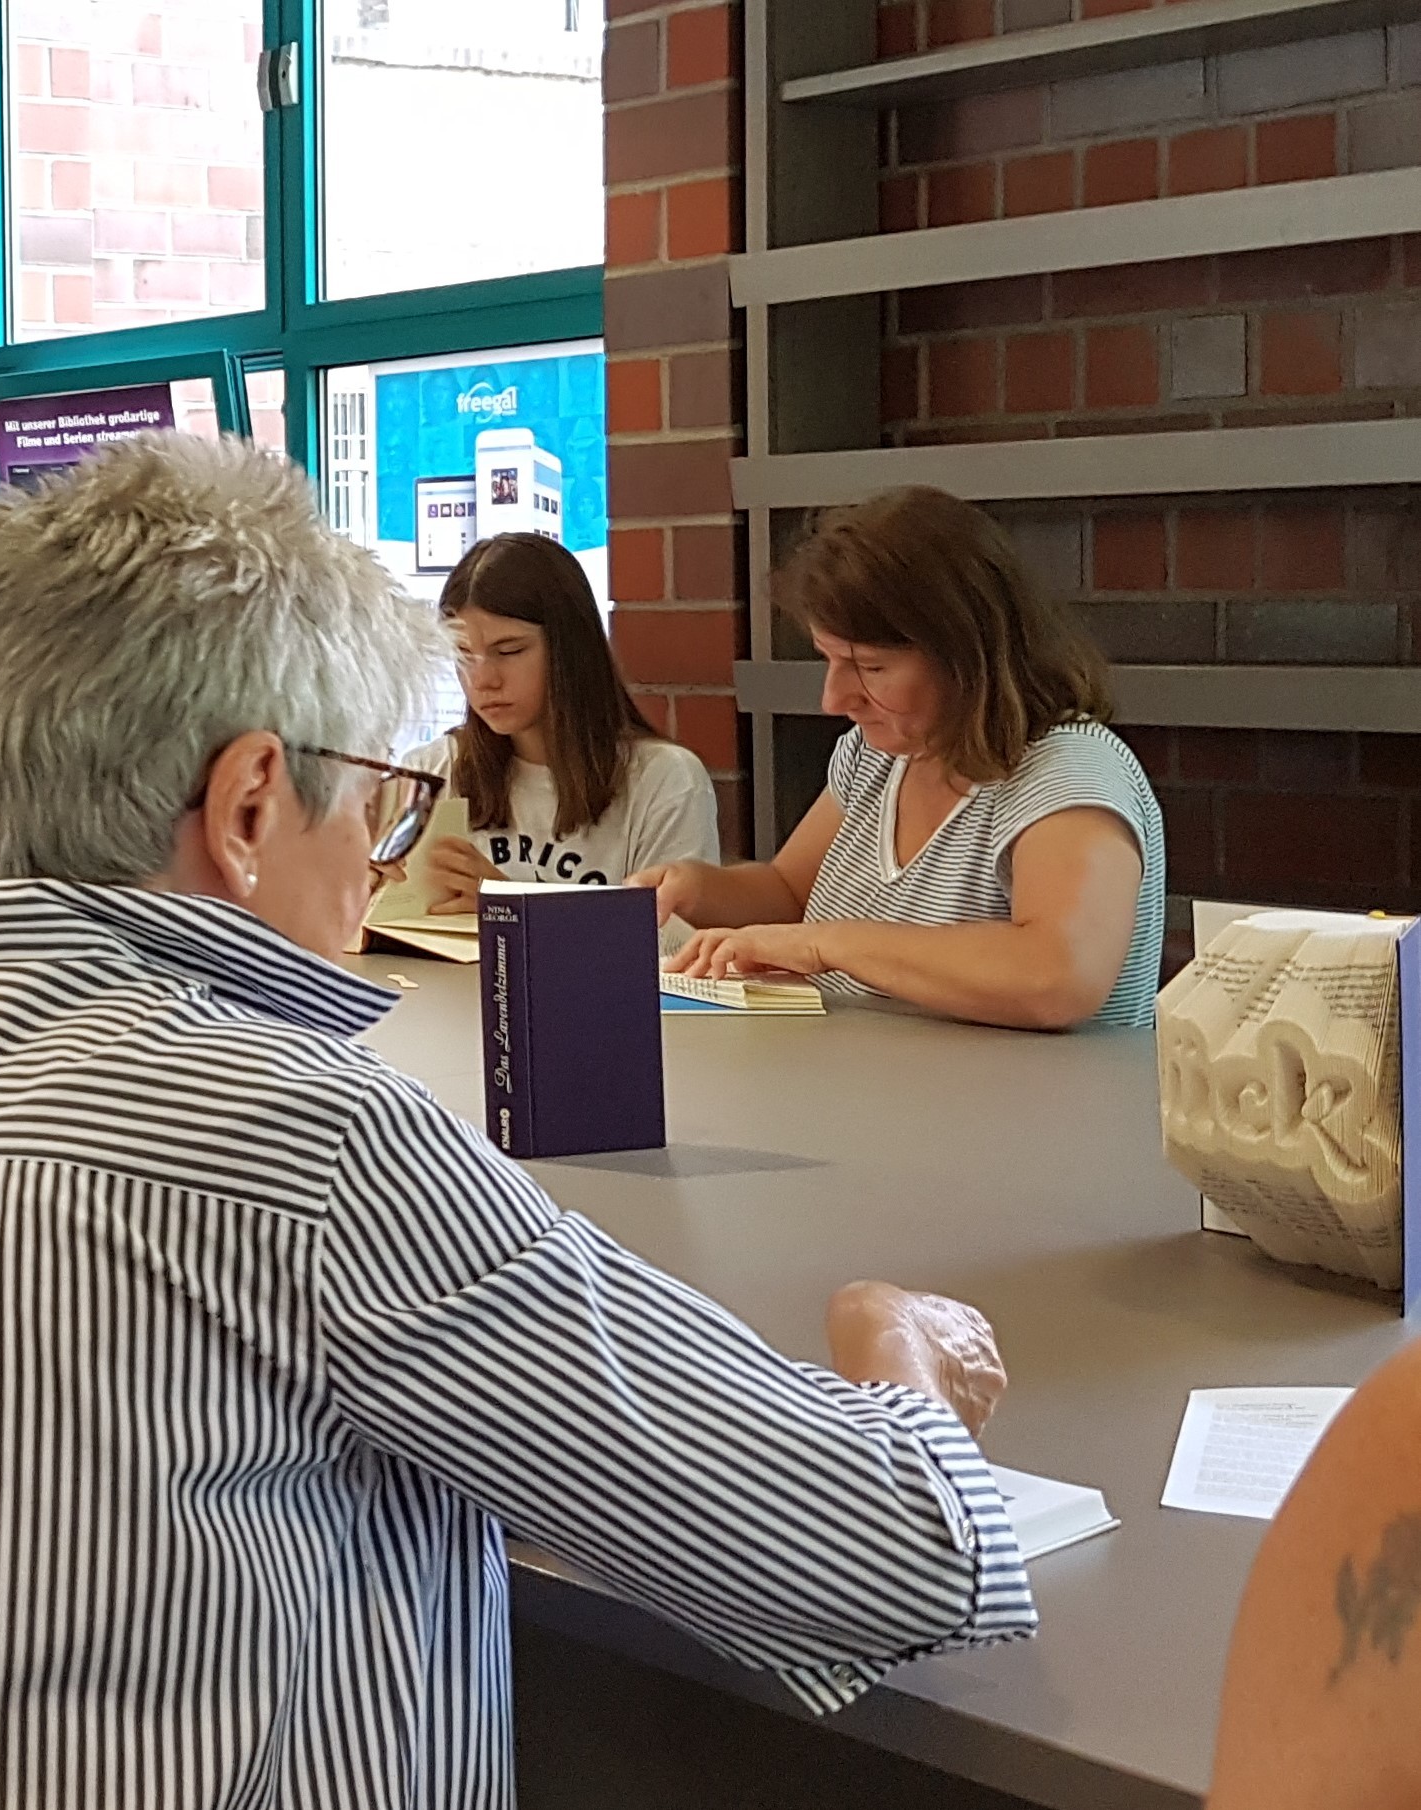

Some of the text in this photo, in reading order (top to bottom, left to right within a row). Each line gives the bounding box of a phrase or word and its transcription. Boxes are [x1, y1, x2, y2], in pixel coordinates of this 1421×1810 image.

[456, 385, 517, 415] freegal
[4, 409, 159, 432] Mit unserer Bibliothek großartige
[16, 435, 42, 448] Filme
[44, 433, 61, 446] und
[63, 432, 94, 446] Serien
[486, 905, 512, 915] NINA
[493, 935, 513, 1094] Das Lavendelzimmer
